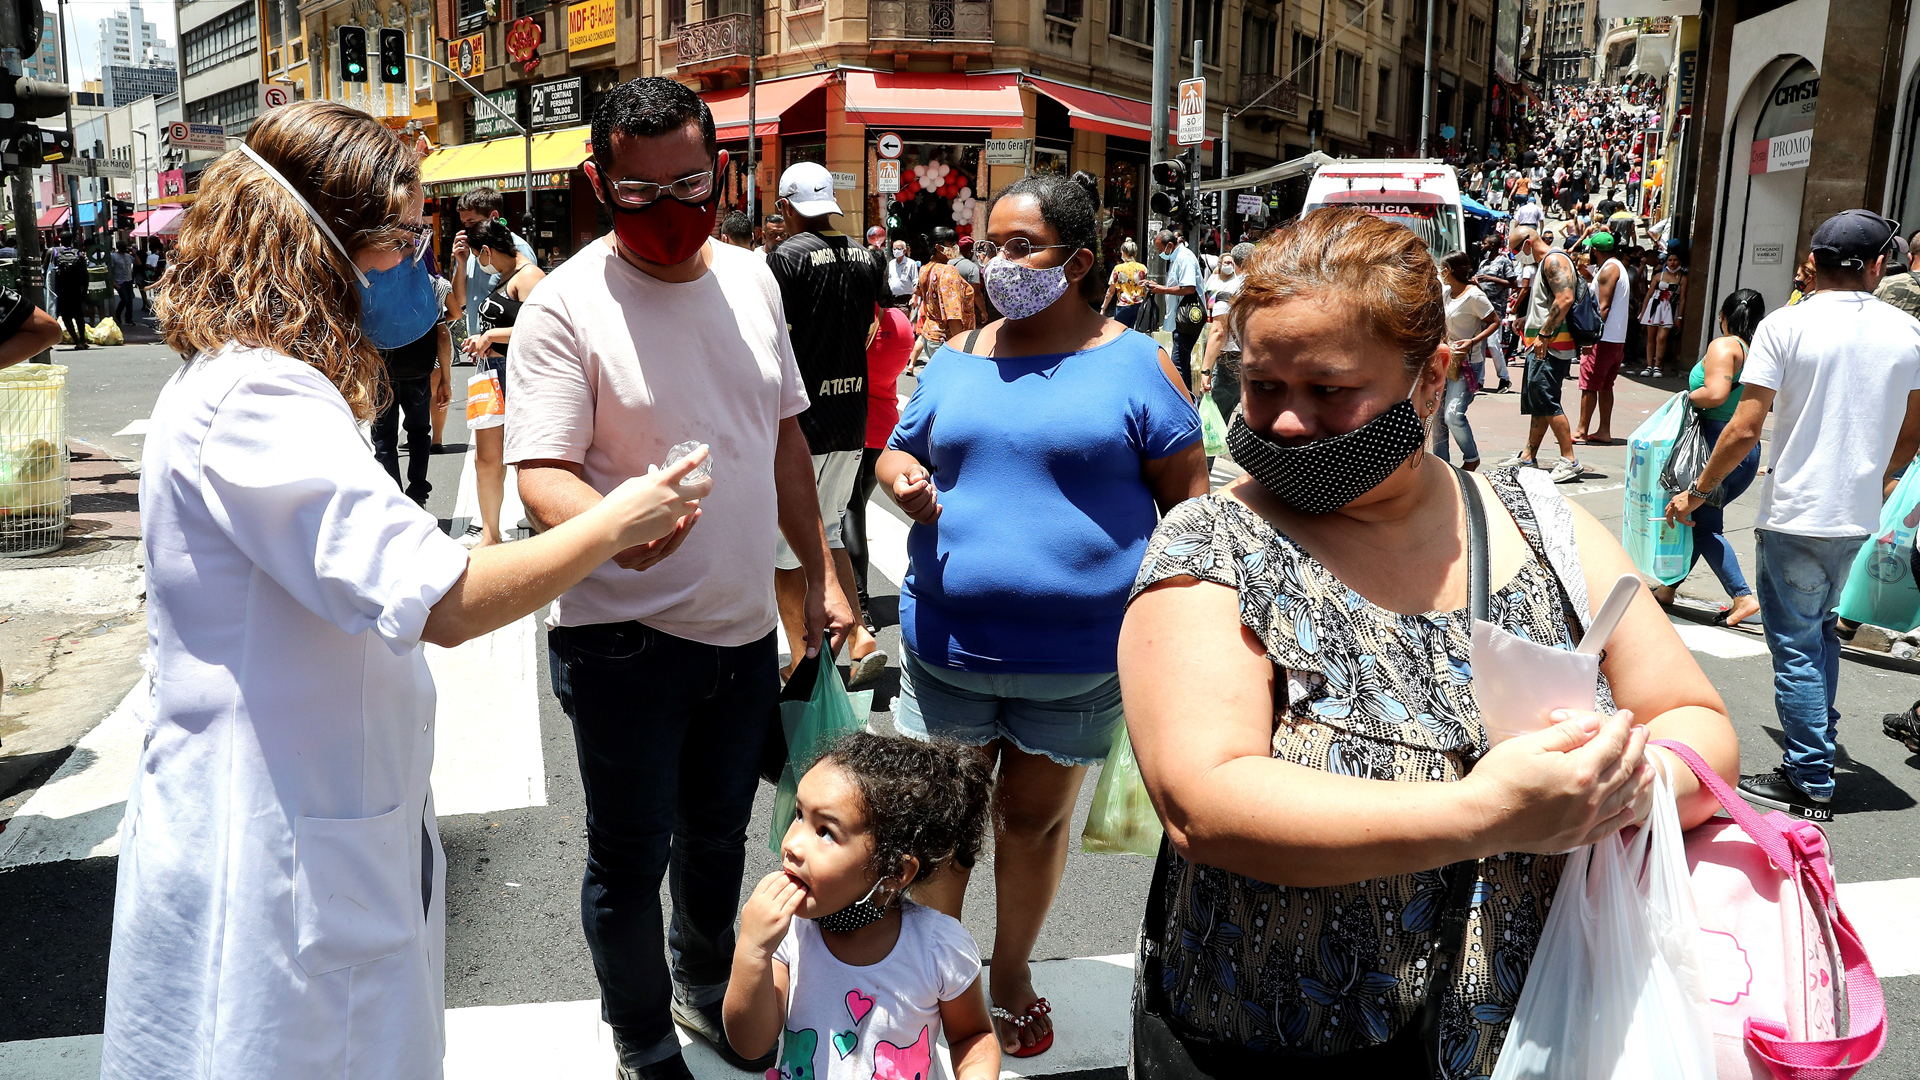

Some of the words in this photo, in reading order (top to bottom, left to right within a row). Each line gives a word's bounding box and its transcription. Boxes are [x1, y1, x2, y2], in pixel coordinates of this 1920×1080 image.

[544, 85, 556, 93] PAPEL
[563, 80, 579, 90] PAREDE
[551, 90, 572, 100] CORTINAS
[533, 89, 544, 112] 2º
[550, 97, 574, 107] PERSIANAS
[553, 106, 571, 115] TOLDOS
[175, 126, 183, 137] E
[986, 140, 1006, 151] Porto
[1007, 140, 1026, 150] Geral
[110, 160, 130, 170] Março
[840, 174, 856, 182] Geral
[819, 376, 863, 396] ATLETA
